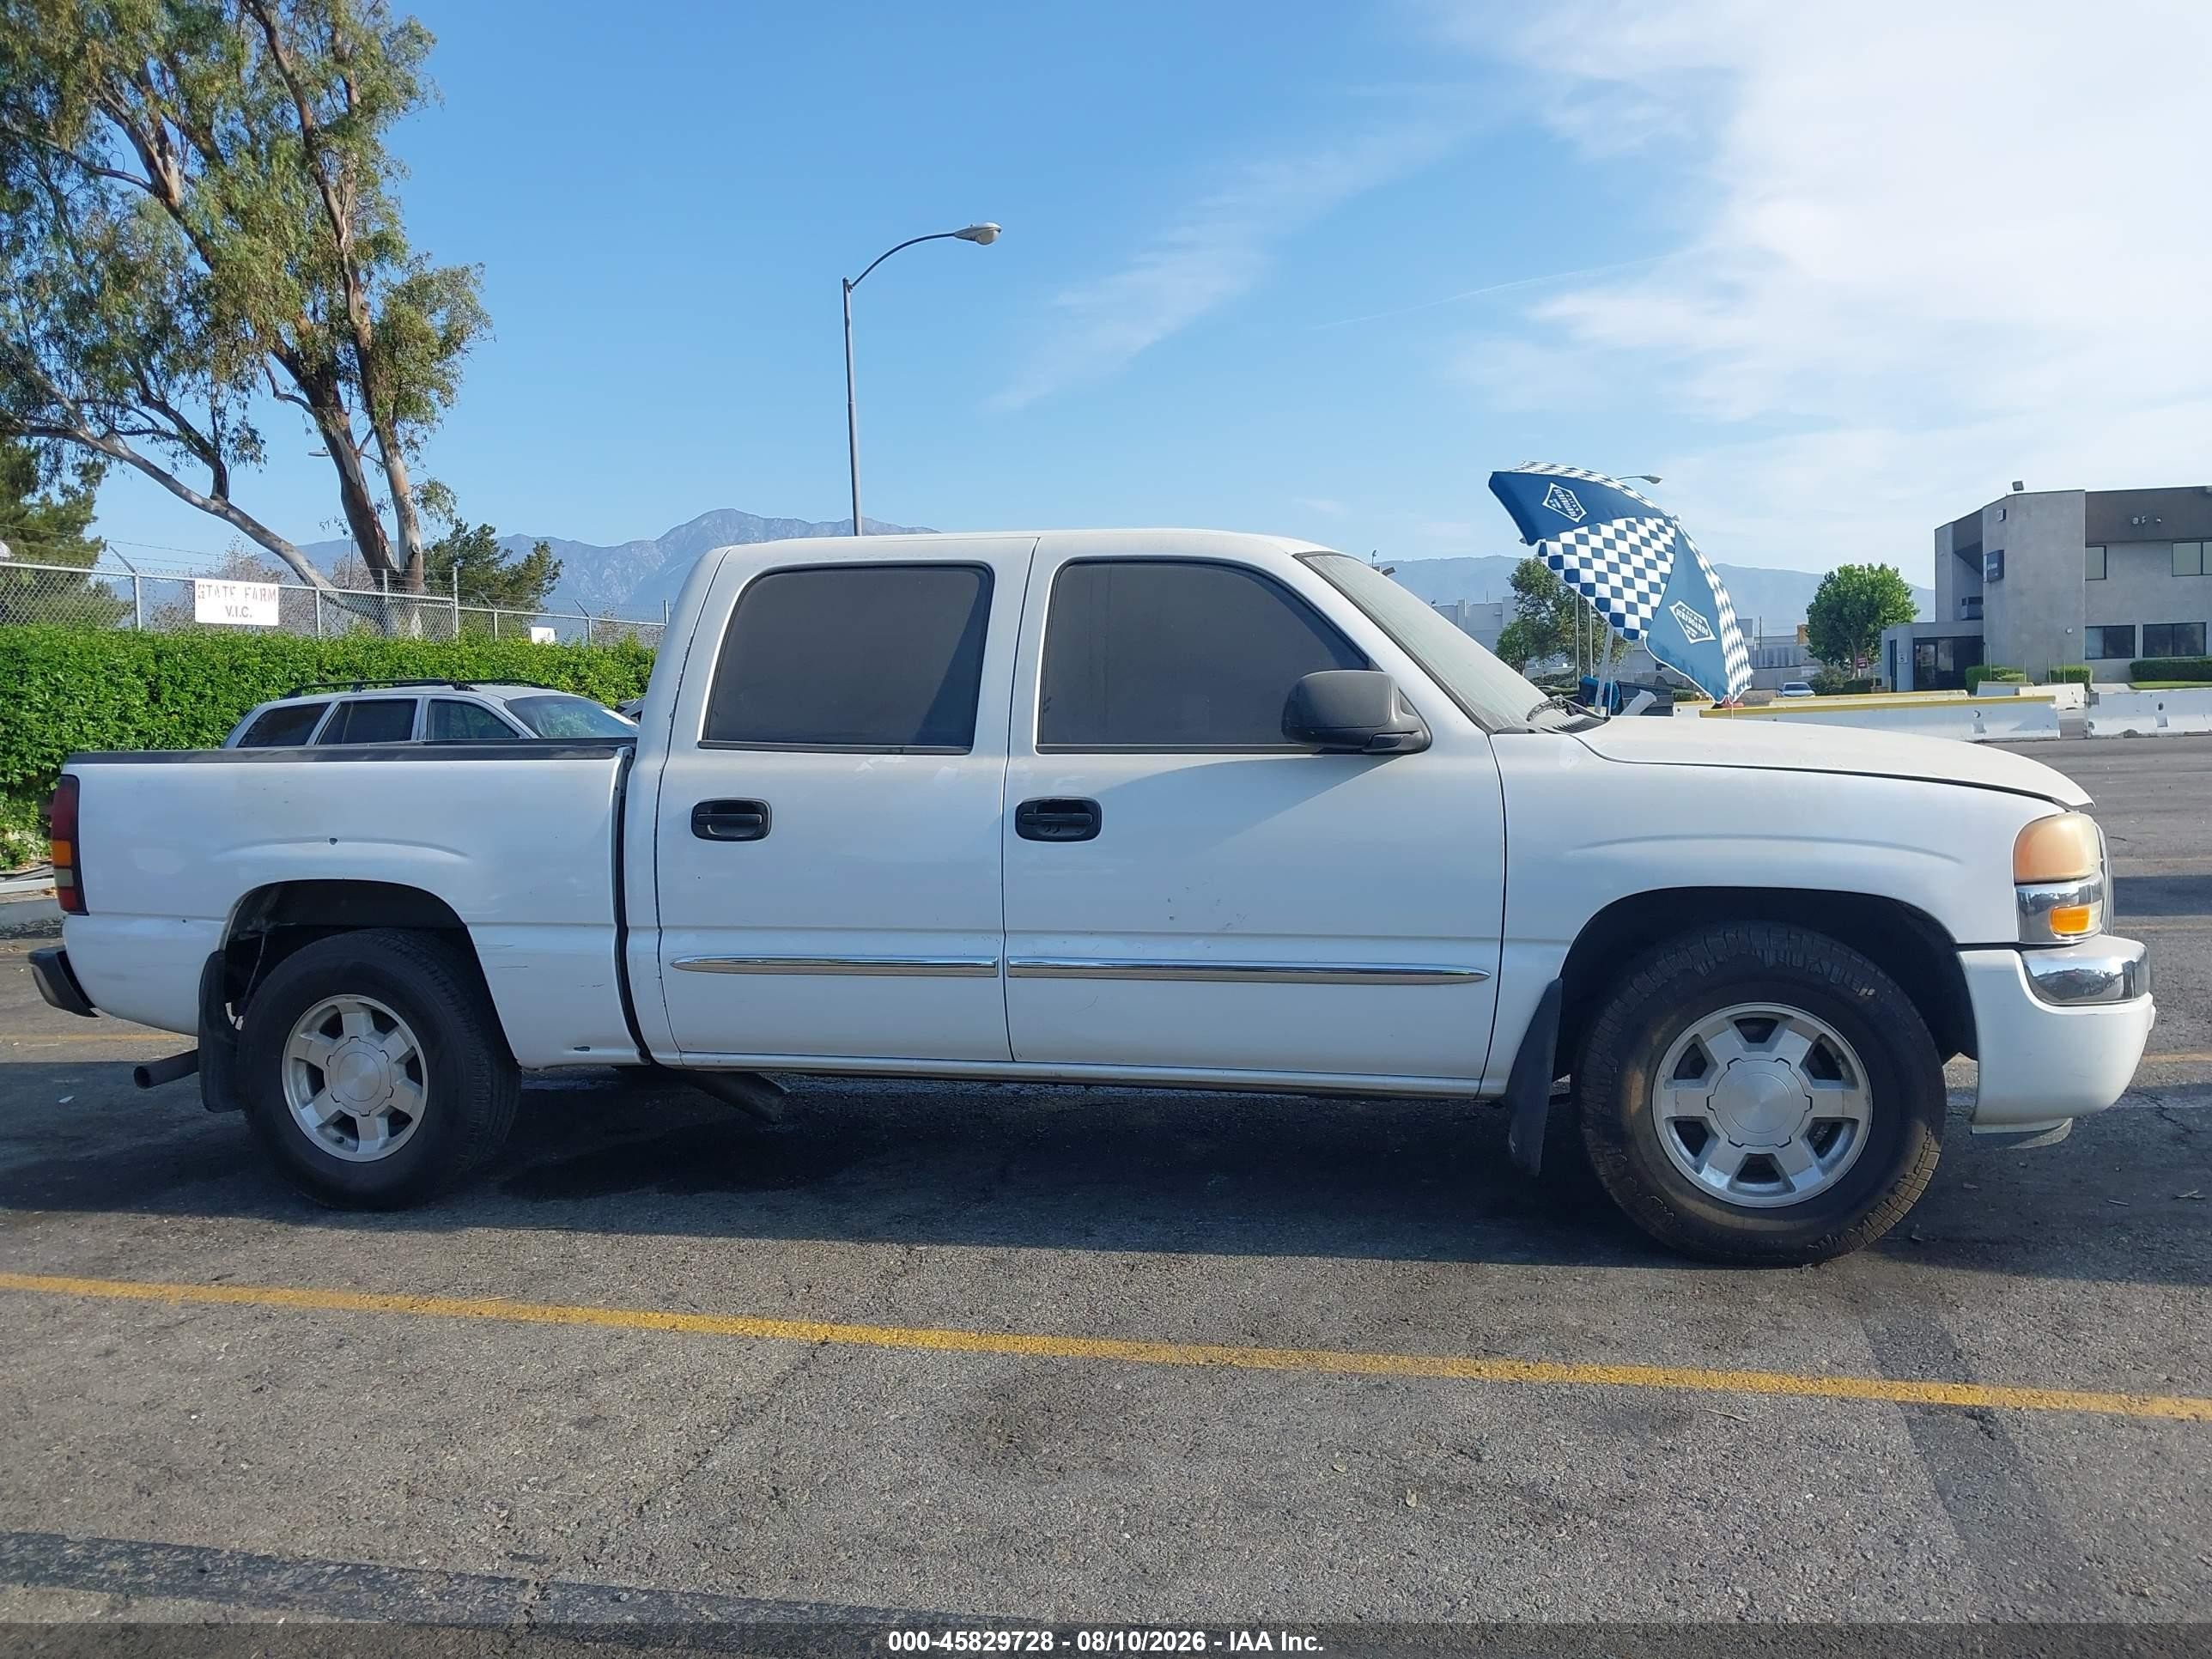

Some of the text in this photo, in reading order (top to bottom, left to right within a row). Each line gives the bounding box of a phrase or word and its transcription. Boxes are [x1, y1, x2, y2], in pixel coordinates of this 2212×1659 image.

[198, 583, 276, 603] STATE FARM
[225, 605, 252, 618] V.I.C.
